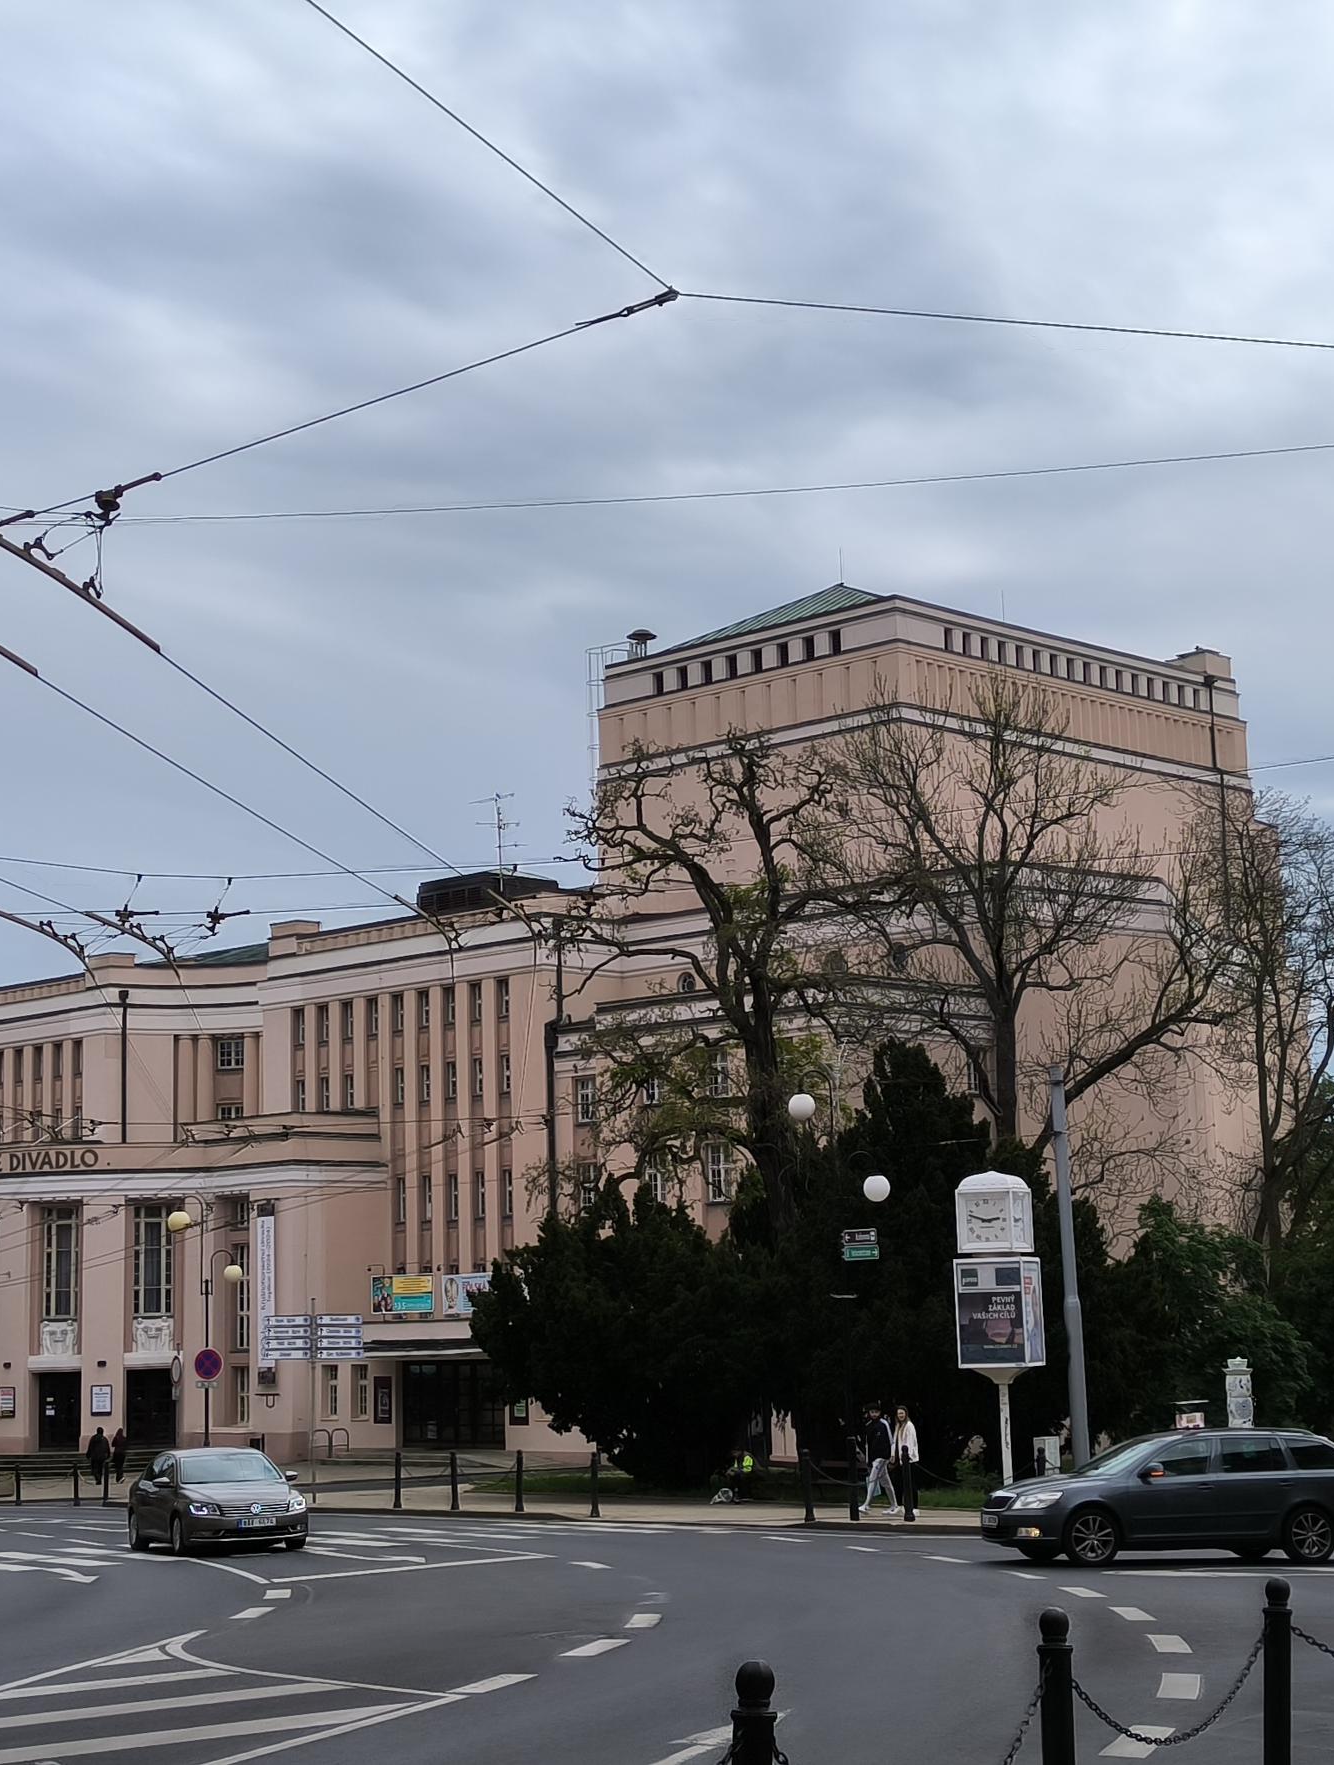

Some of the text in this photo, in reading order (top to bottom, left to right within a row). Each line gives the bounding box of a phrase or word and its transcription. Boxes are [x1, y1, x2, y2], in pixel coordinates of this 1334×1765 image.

[9, 1150, 99, 1171] DIVADLO
[991, 1294, 1015, 1303] PEVNÝ
[988, 1303, 1015, 1311] ZÁKLAD
[972, 1309, 1016, 1319] VAŠICH CÍLŮ
